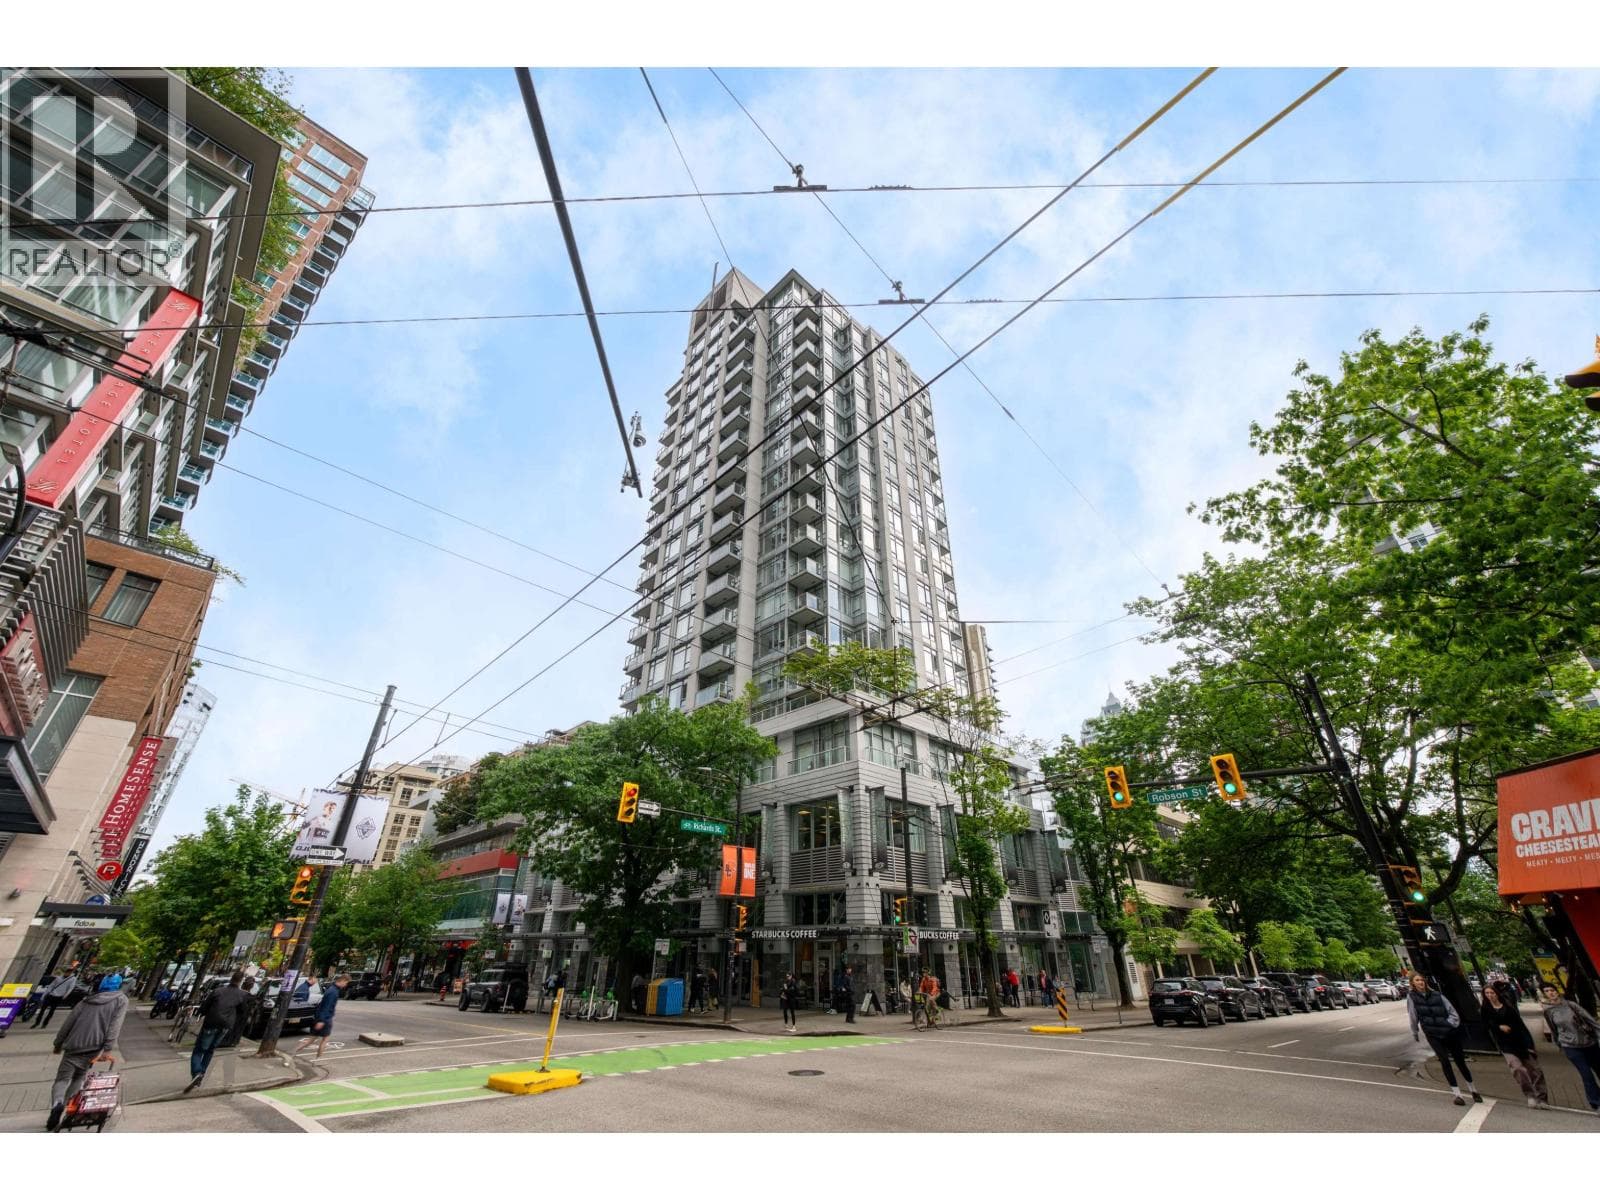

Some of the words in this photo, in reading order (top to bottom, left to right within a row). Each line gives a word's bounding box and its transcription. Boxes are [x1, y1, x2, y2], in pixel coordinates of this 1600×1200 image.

[104, 741, 158, 826] HOMESENSE
[1151, 790, 1189, 803] Robson
[1191, 787, 1204, 797] St
[1516, 833, 1600, 858] CHEESESTEA
[1526, 859, 1548, 868] MEATY
[1555, 855, 1577, 864] MELTY
[751, 930, 790, 939] STARBUCKS
[790, 929, 817, 939] COFFEE
[939, 931, 960, 940] COFFEE
